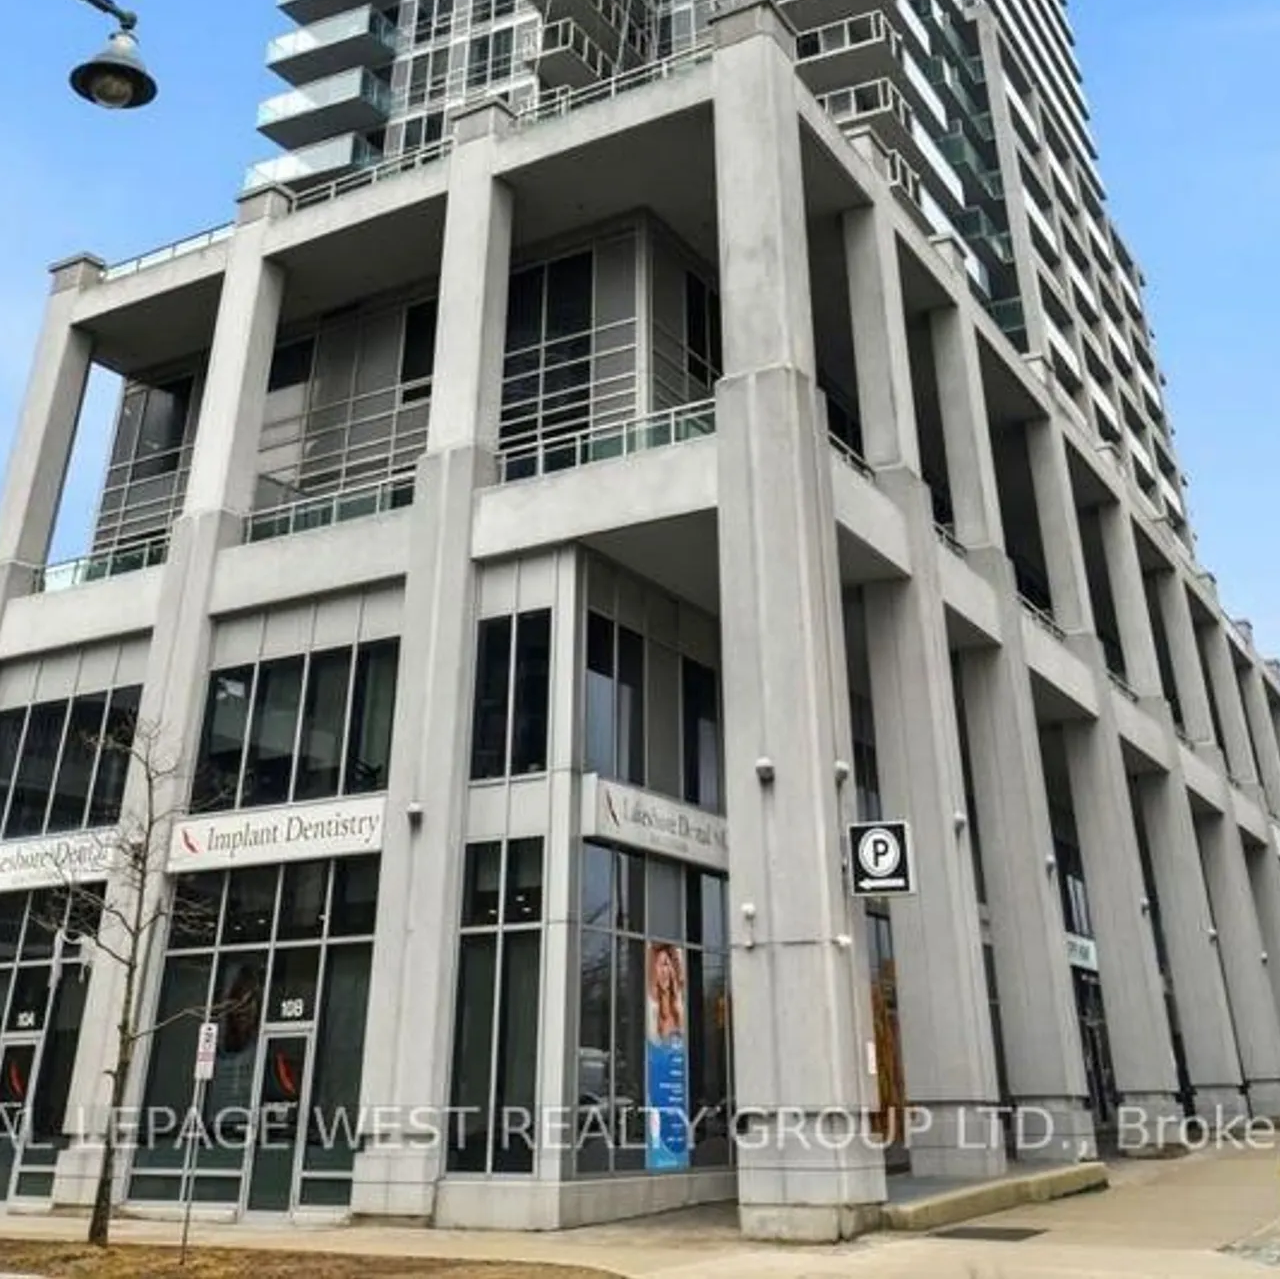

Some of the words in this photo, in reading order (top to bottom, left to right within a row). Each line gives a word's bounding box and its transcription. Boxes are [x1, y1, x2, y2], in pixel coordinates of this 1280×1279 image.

[206, 822, 278, 858] Implant
[285, 811, 380, 844] Dentistry
[872, 838, 889, 868] P
